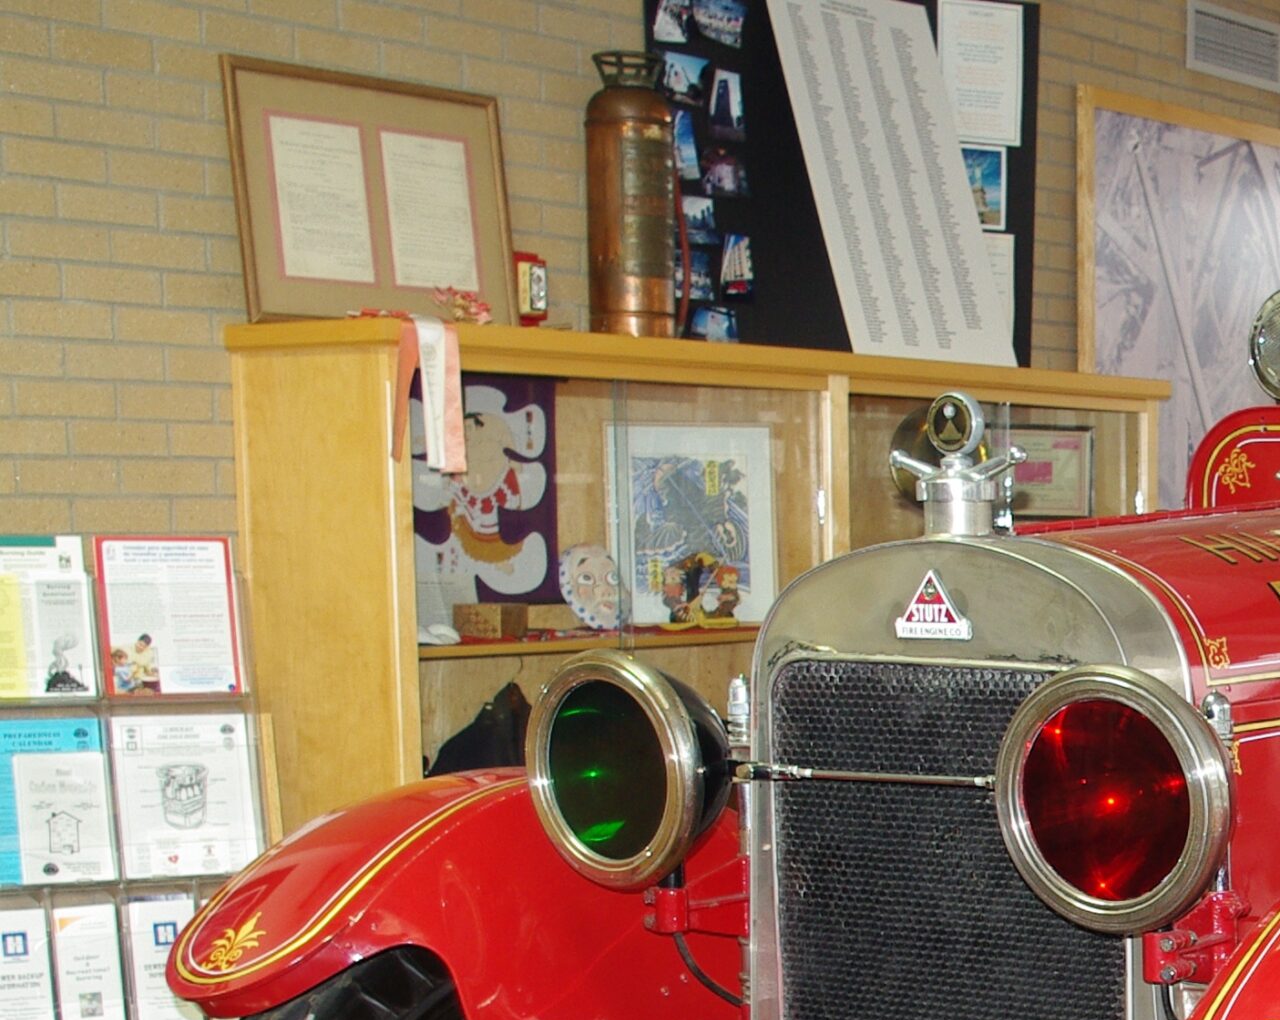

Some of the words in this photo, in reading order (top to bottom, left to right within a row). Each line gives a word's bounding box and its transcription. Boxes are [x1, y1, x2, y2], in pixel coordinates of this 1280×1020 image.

[911, 603, 949, 623] STUTZ
[902, 626, 919, 636] FIRE
[920, 626, 947, 636] ENGINE
